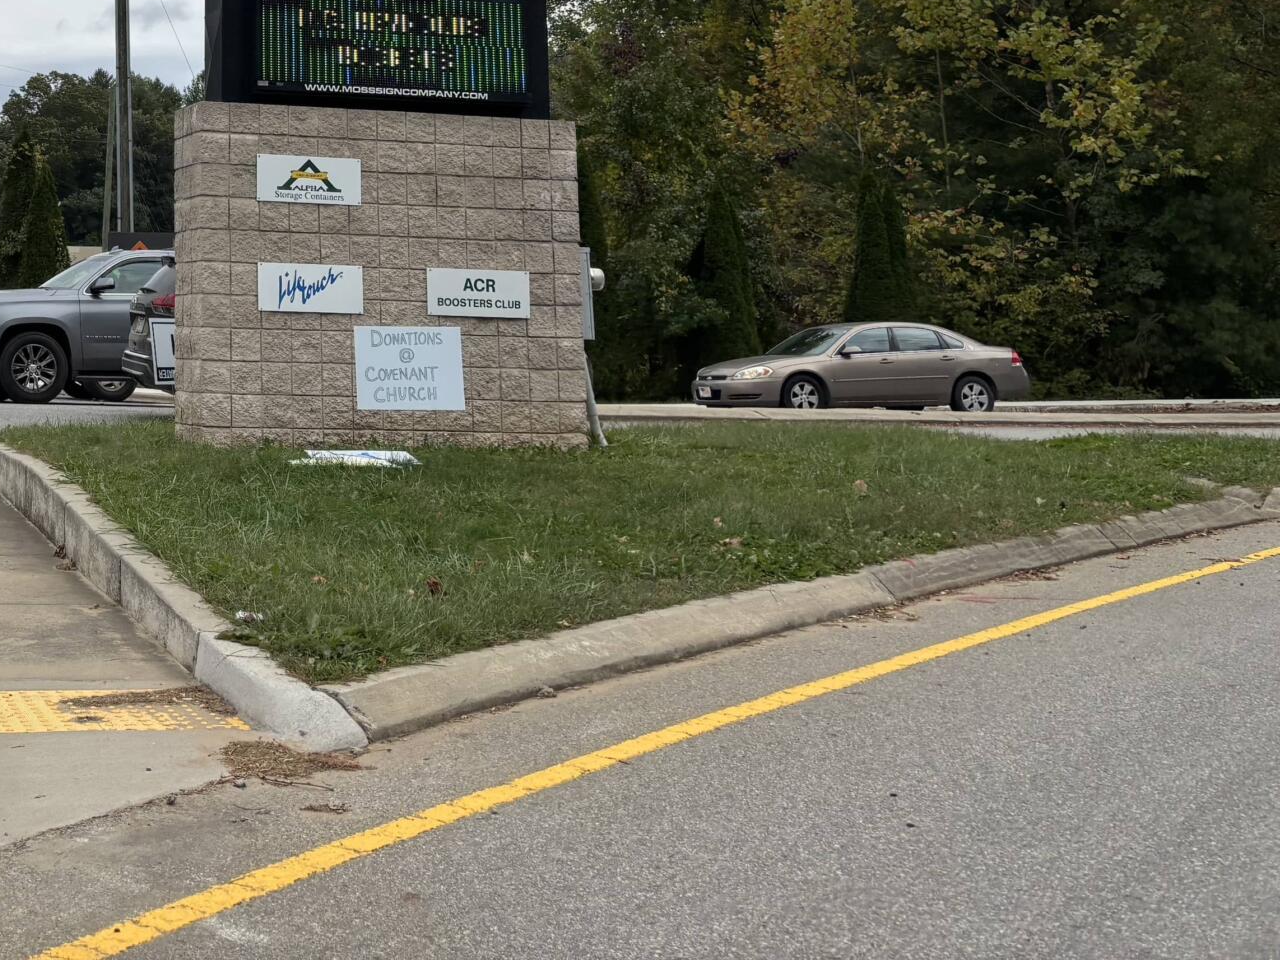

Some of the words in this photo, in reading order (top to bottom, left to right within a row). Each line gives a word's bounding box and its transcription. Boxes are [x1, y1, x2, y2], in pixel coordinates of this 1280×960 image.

[304, 83, 489, 101] WWW.MOSSSIGNCOMPANY.COM
[274, 190, 303, 201] Storage
[304, 191, 345, 201] Containers
[463, 278, 496, 293] ACR
[437, 297, 493, 309] BOOSTERS
[494, 299, 521, 310] CLUB
[370, 329, 443, 348] DONATIONS
[399, 347, 415, 364] @
[364, 366, 439, 383] COVENANT
[373, 386, 438, 404] CHURCH
